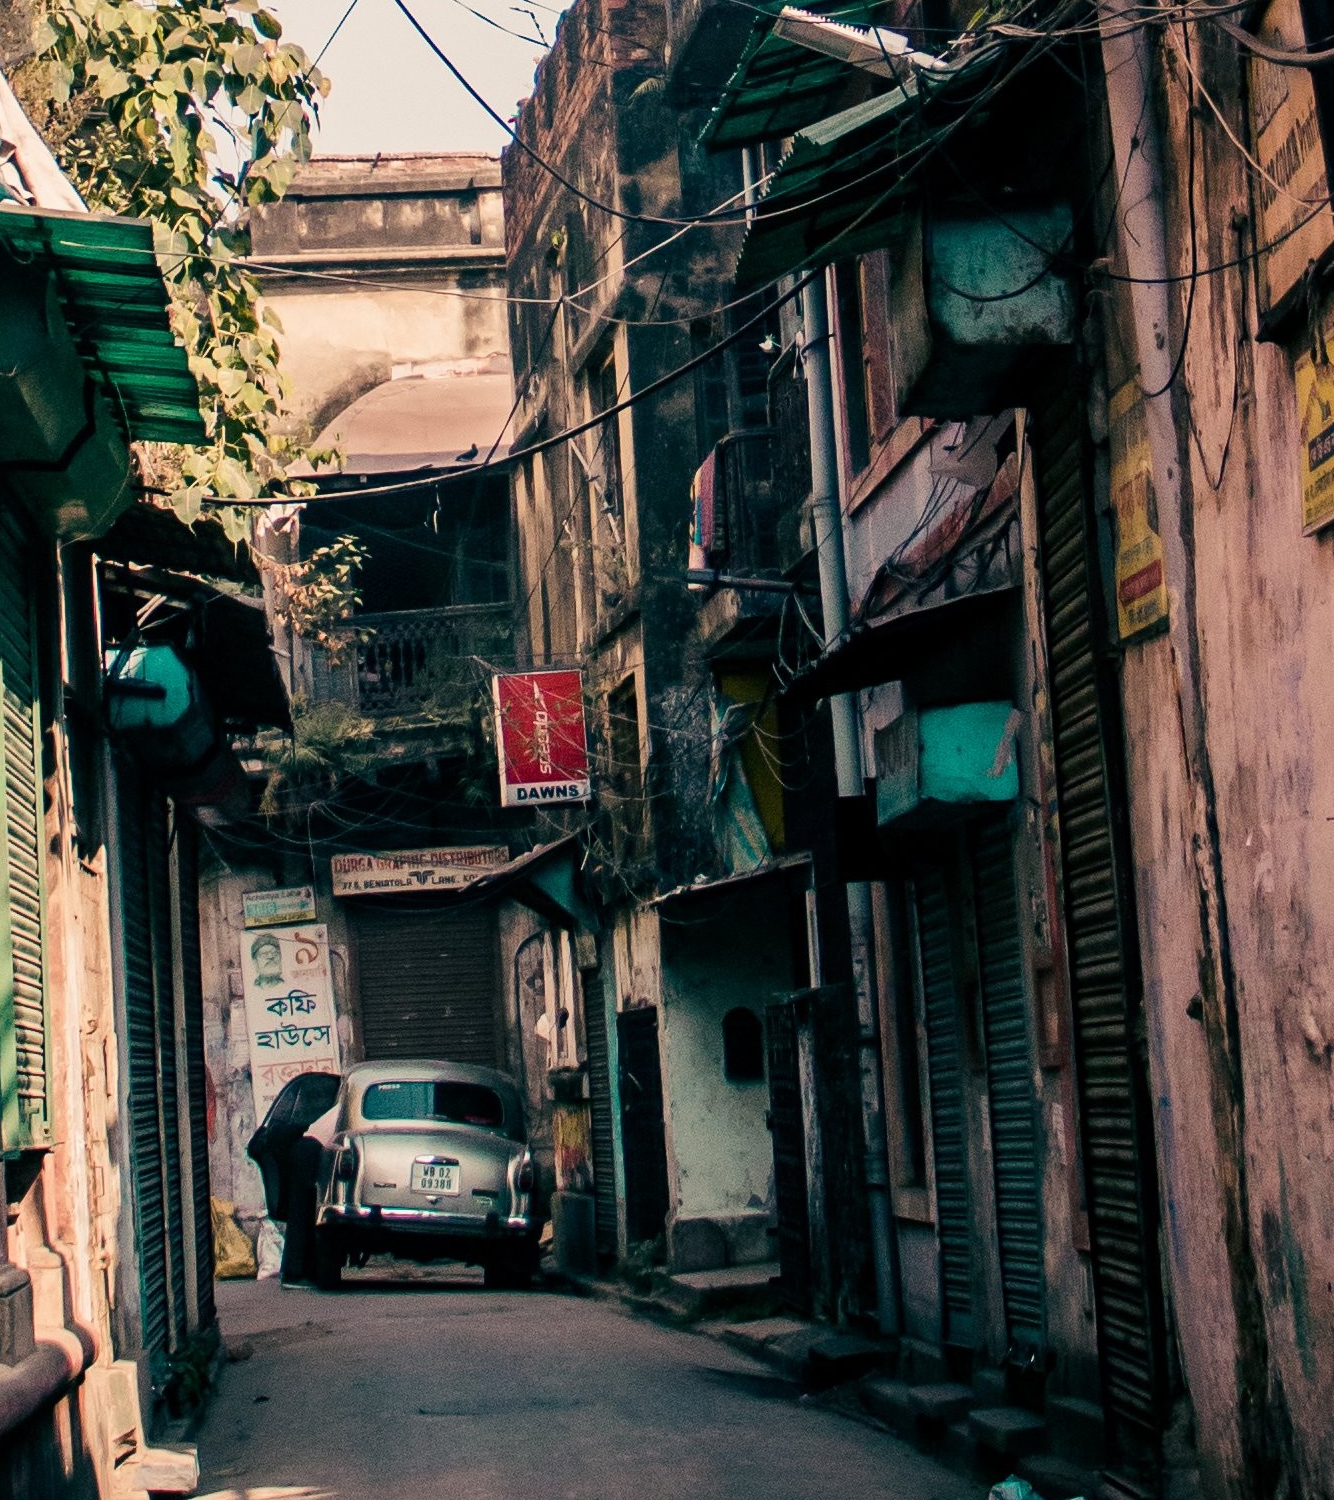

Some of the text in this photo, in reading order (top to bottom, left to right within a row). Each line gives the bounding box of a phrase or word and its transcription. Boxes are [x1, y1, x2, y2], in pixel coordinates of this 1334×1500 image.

[517, 784, 579, 800] DAWNS
[334, 857, 373, 873] DURGA
[294, 931, 319, 964] ৯
[264, 989, 316, 1017] কফি
[255, 1021, 331, 1050] হাউসে
[438, 1167, 451, 1179] 02
